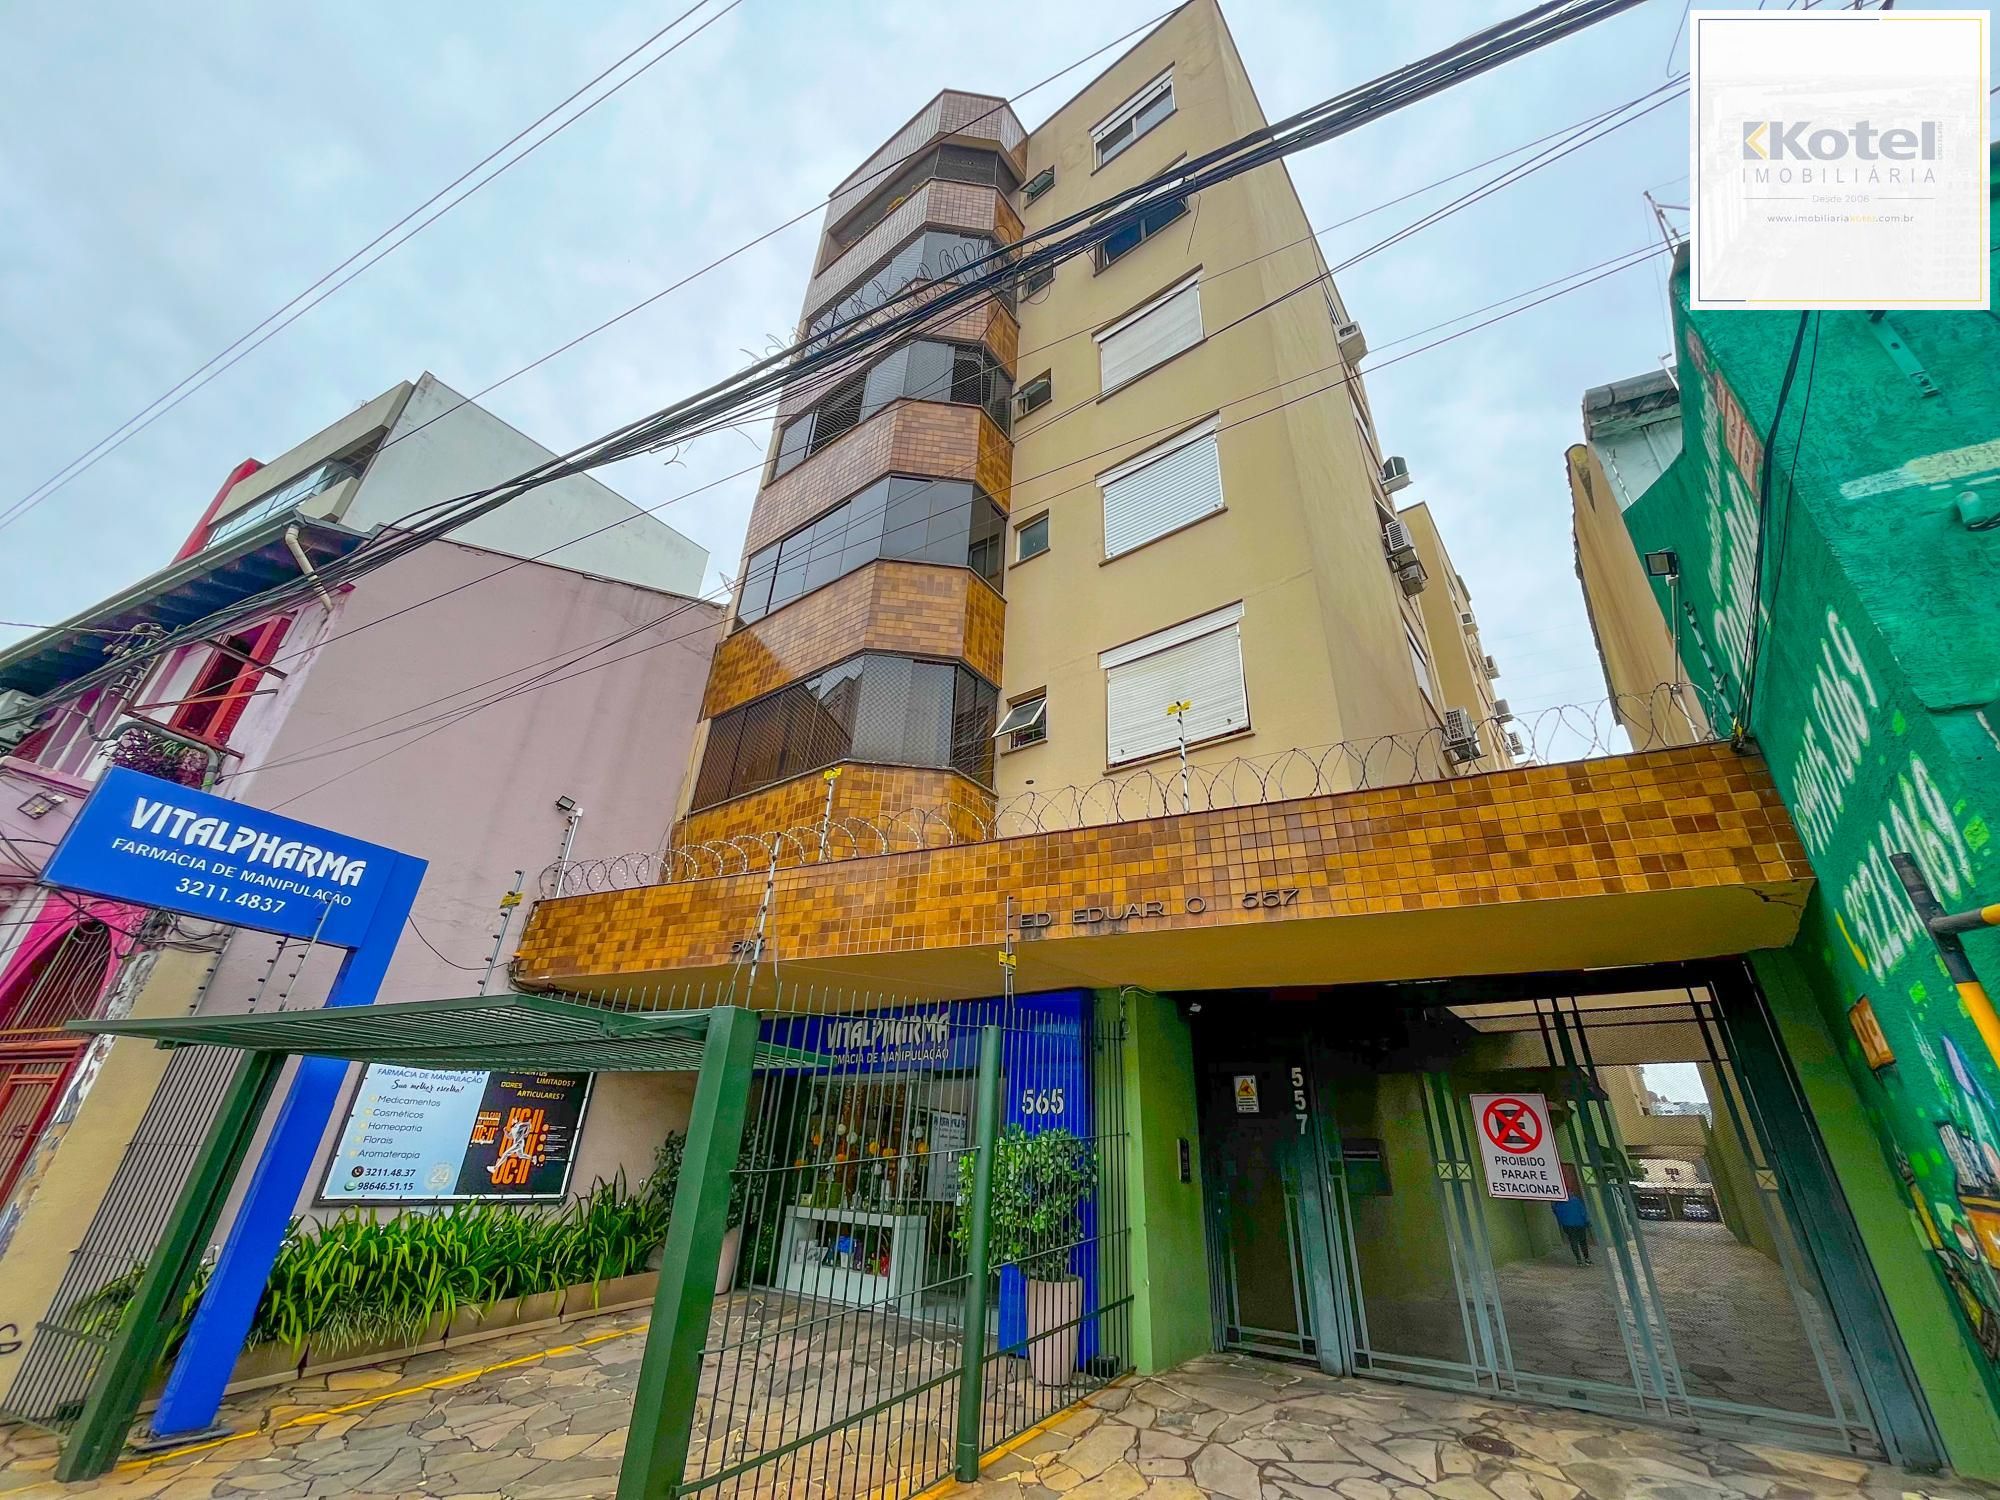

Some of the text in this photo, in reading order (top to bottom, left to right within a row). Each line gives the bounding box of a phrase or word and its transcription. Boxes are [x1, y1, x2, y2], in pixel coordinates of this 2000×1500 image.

[130, 797, 368, 887] VITALPHARMA
[111, 837, 353, 908] FARMÁCIA DE MANIPULAÇÃO
[175, 877, 286, 914] 3211.4837
[1019, 911, 1052, 929] ED
[1241, 888, 1300, 909] 557
[827, 1011, 950, 1050] VITALPHARMA
[866, 1052, 879, 1064] DE
[377, 1068, 483, 1084] FARMÁCIA DE MANIPULAÇÃO
[377, 1095, 441, 1107] Medicamentos
[1021, 1088, 1064, 1115] 565
[373, 1108, 424, 1119] Cosméticos
[368, 1121, 423, 1133] Homeopatia
[363, 1135, 394, 1145] Florais
[358, 1149, 421, 1161] Aromaterapia
[1494, 1155, 1546, 1167] PROIBIDO
[365, 1168, 416, 1177] 3211.48.37
[1501, 1169, 1549, 1180] PARAR E
[357, 1182, 414, 1191] 98646.51.15
[1492, 1182, 1562, 1195] ESTACIONAR
